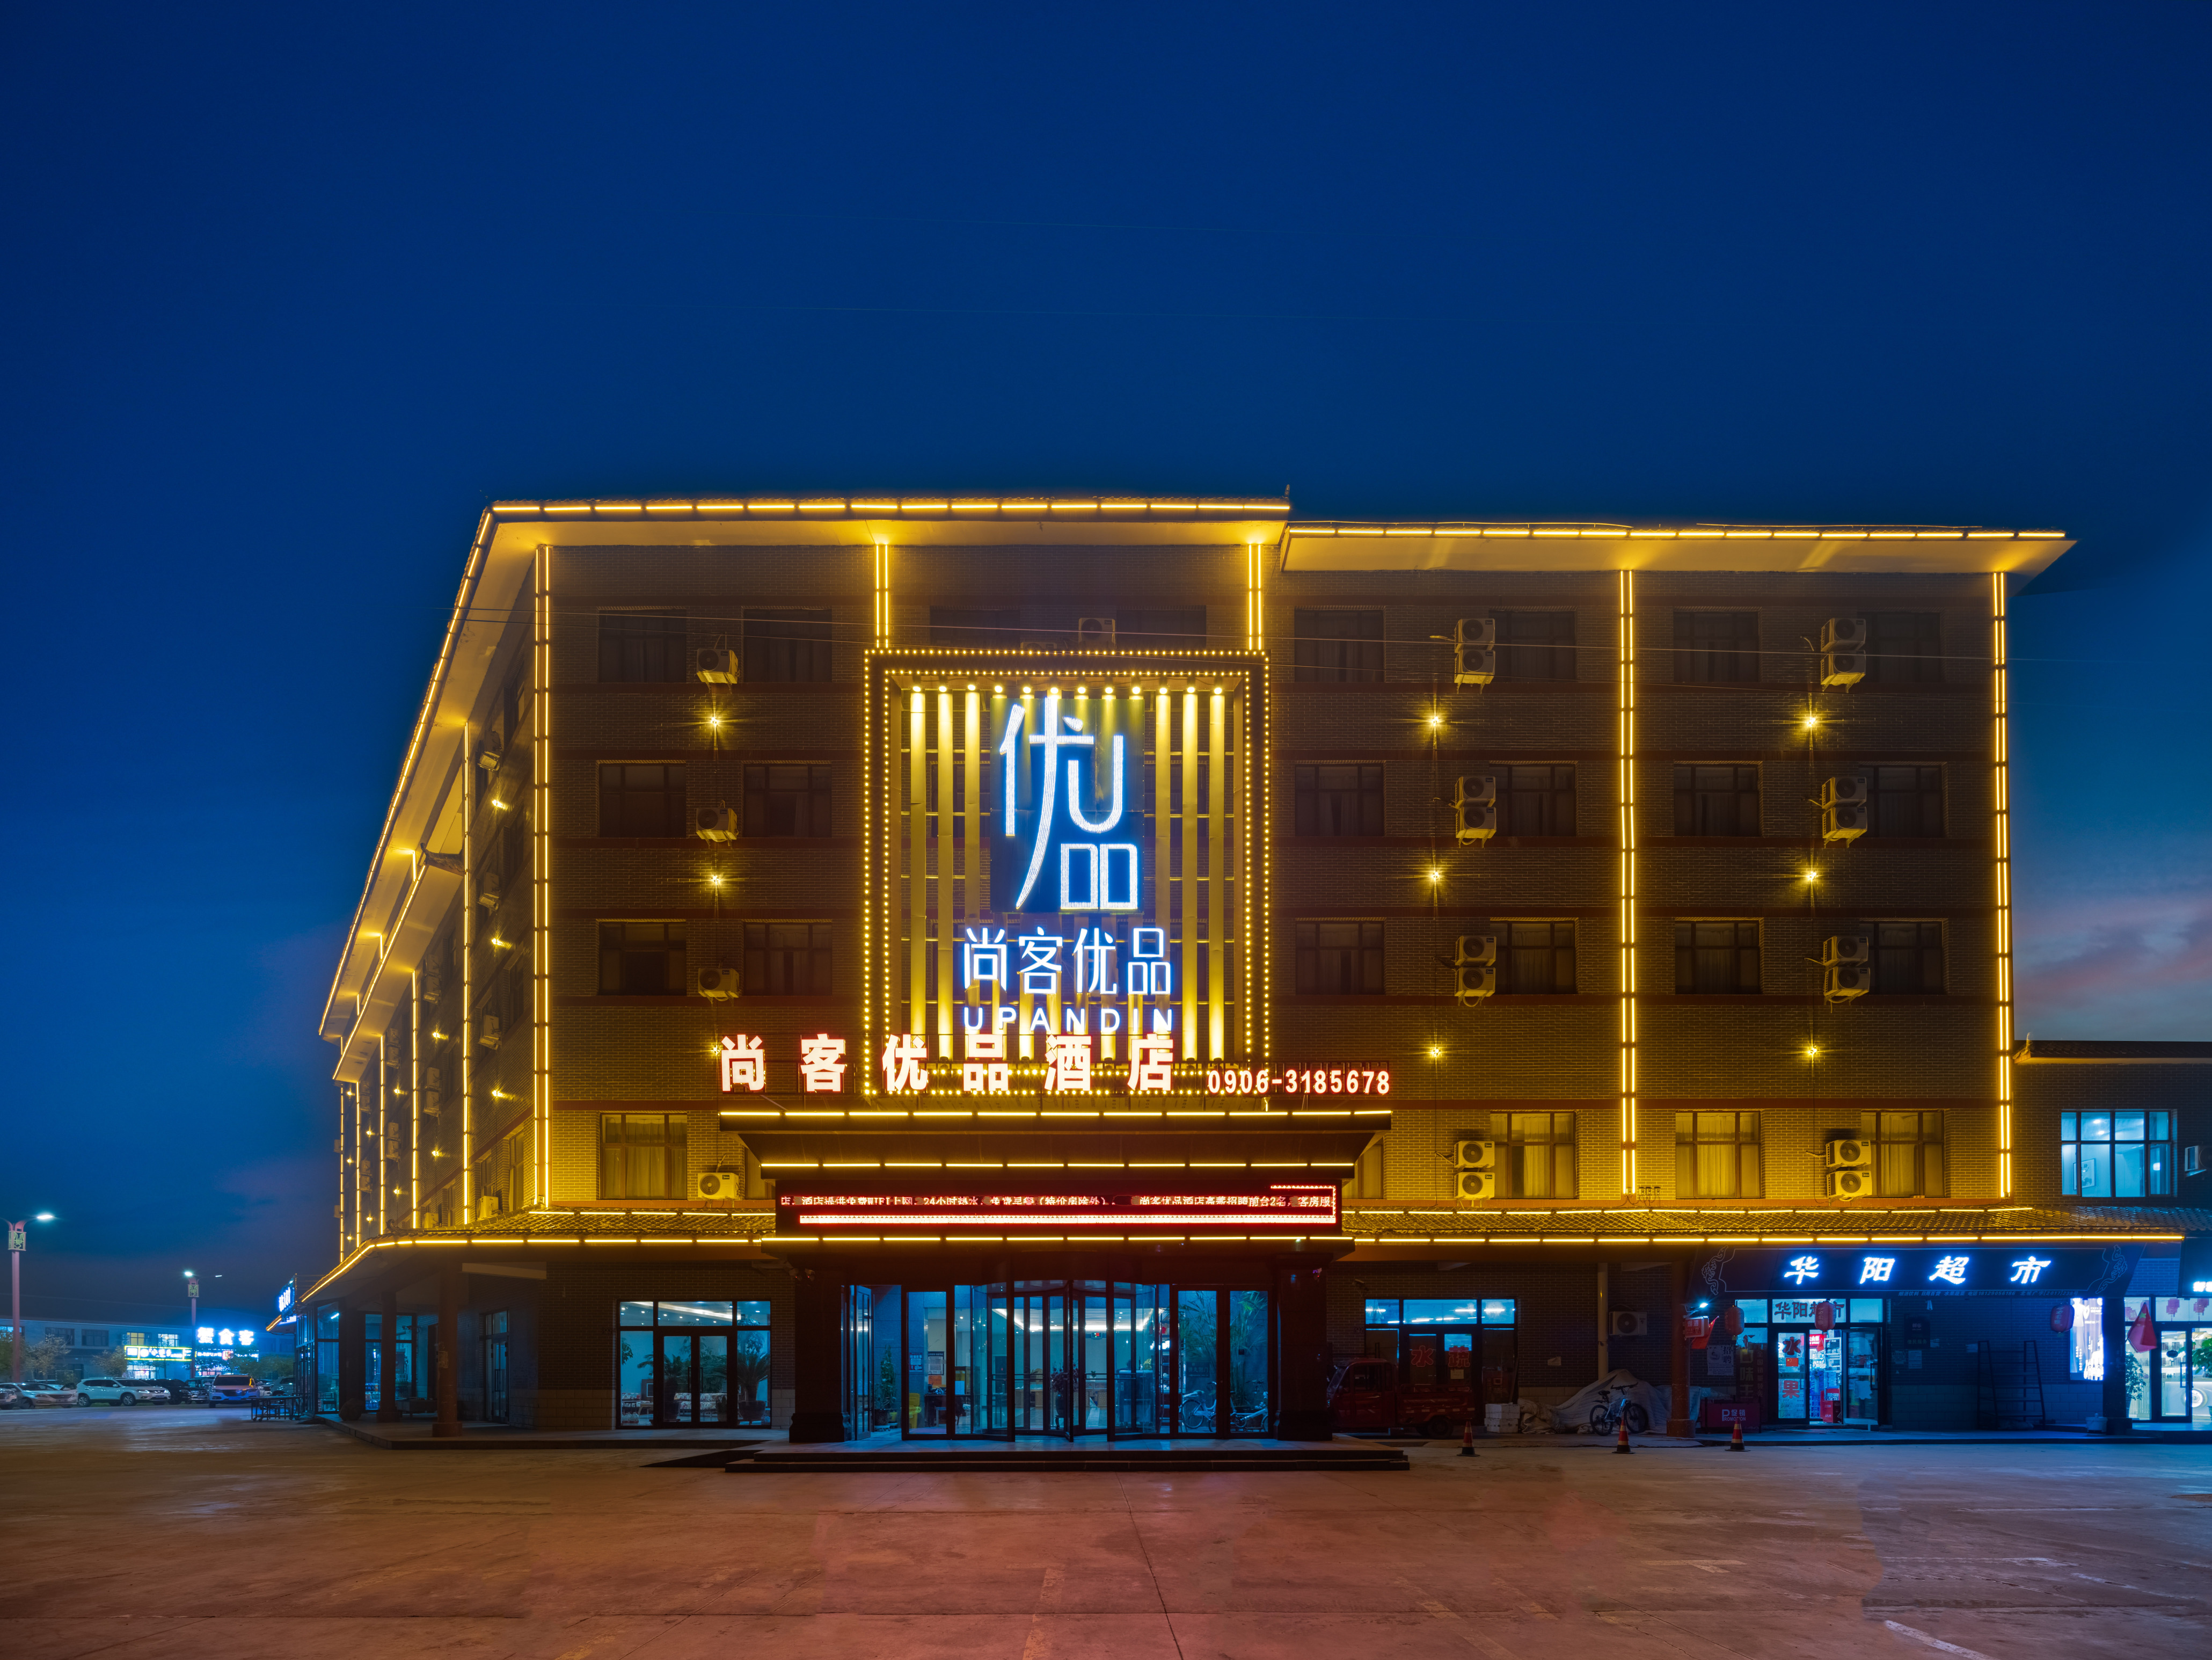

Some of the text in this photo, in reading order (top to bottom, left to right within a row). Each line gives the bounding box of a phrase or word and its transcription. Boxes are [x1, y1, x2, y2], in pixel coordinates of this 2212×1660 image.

[963, 926, 1172, 995] 尚客优品
[963, 1007, 1173, 1033] UPANDIN
[721, 1033, 1389, 1094] 尚客优品酒店 0906-3185678
[1784, 1256, 2052, 1285] 华阳超市
[1411, 1345, 1434, 1367] 水
[1448, 1346, 1471, 1367] 蔬
[1722, 1346, 1732, 1364] 招聘
